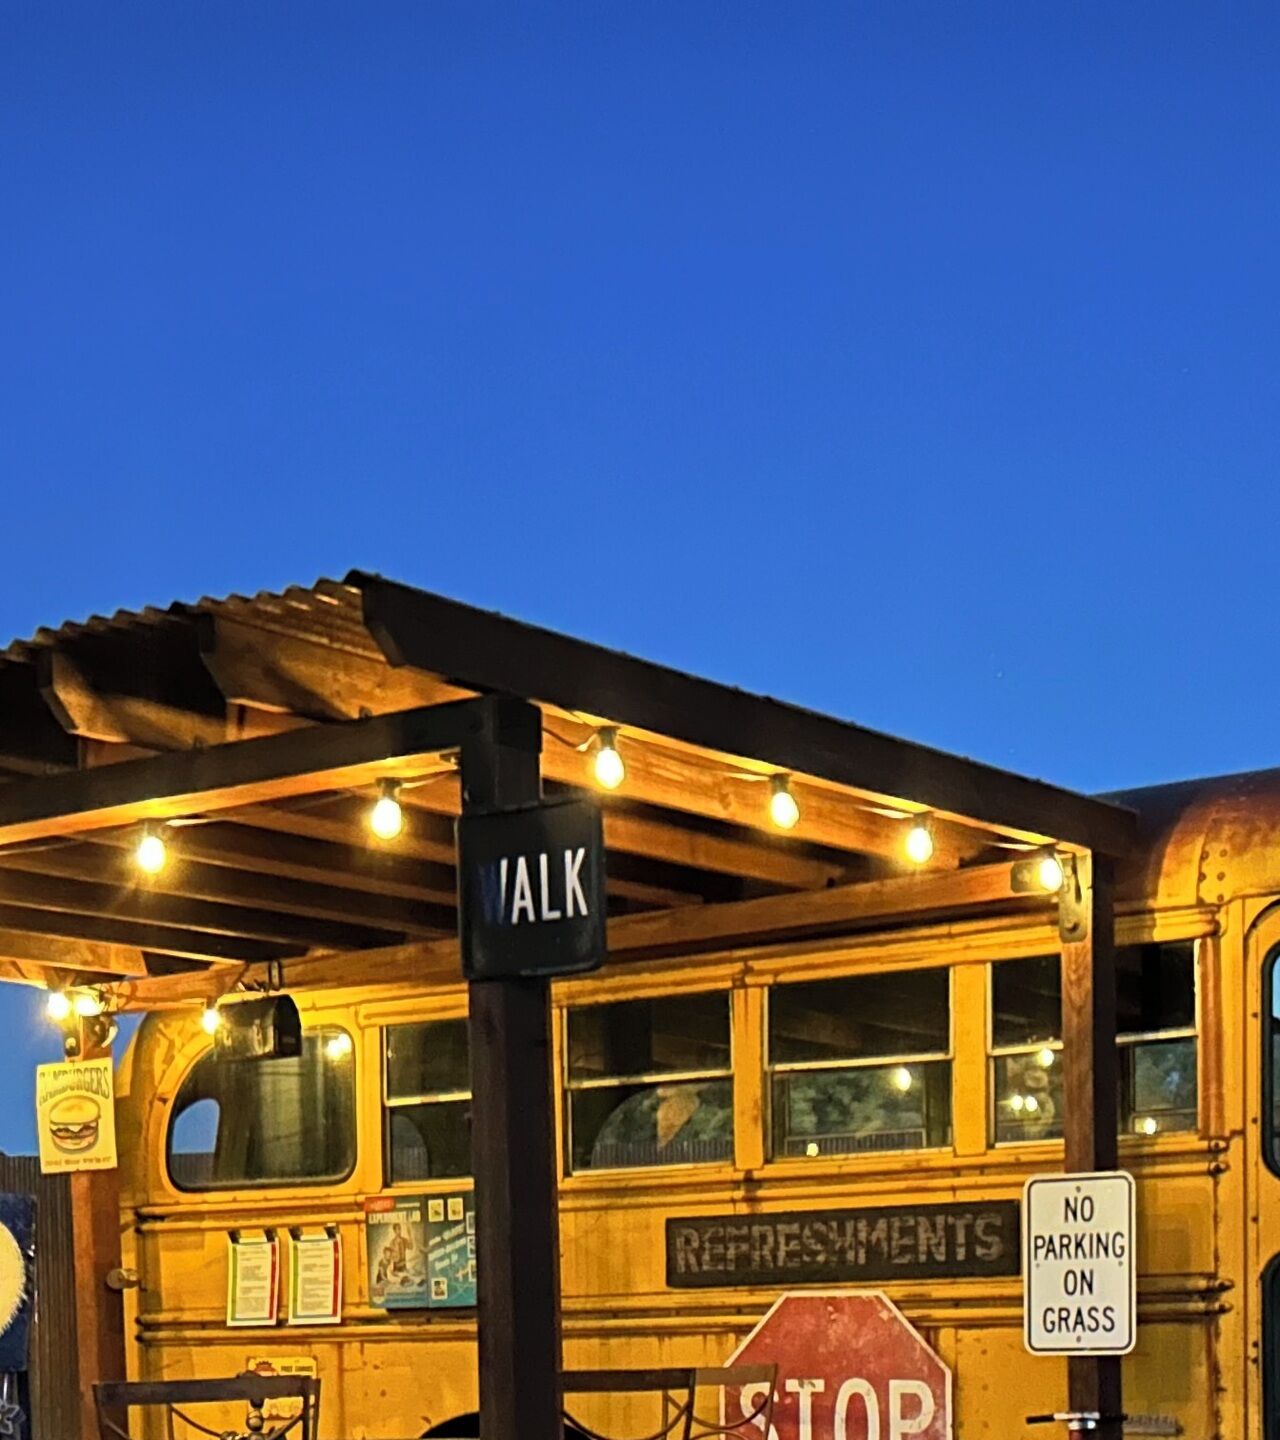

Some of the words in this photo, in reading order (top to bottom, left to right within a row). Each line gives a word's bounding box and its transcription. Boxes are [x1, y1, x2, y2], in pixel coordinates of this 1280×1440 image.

[1064, 1196, 1094, 1223] NO
[675, 1212, 1004, 1274] REFRESHMENTS
[1034, 1232, 1125, 1261] PARKING
[1063, 1269, 1094, 1296] ON
[1042, 1306, 1115, 1334] GRASS
